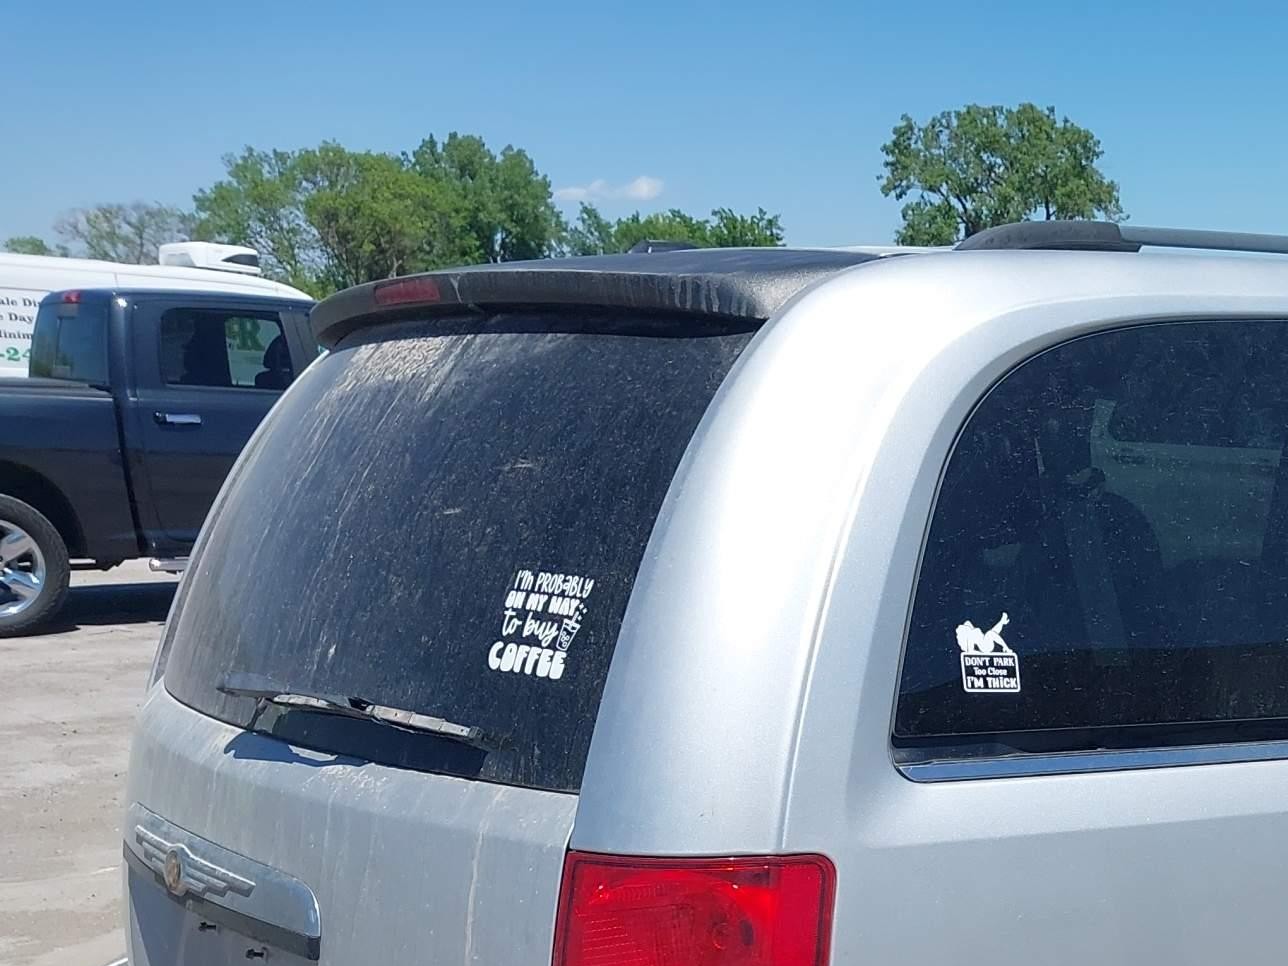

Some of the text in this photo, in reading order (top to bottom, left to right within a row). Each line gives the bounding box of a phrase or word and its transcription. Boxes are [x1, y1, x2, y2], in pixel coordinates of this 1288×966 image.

[0, 330, 32, 339] inim
[505, 591, 580, 616] ON MY WAY
[502, 609, 558, 647] to buy
[488, 641, 567, 679] COFFEE
[965, 657, 1015, 666] DON'T PARK
[973, 667, 1008, 676] Too Close
[967, 676, 985, 688] I'M
